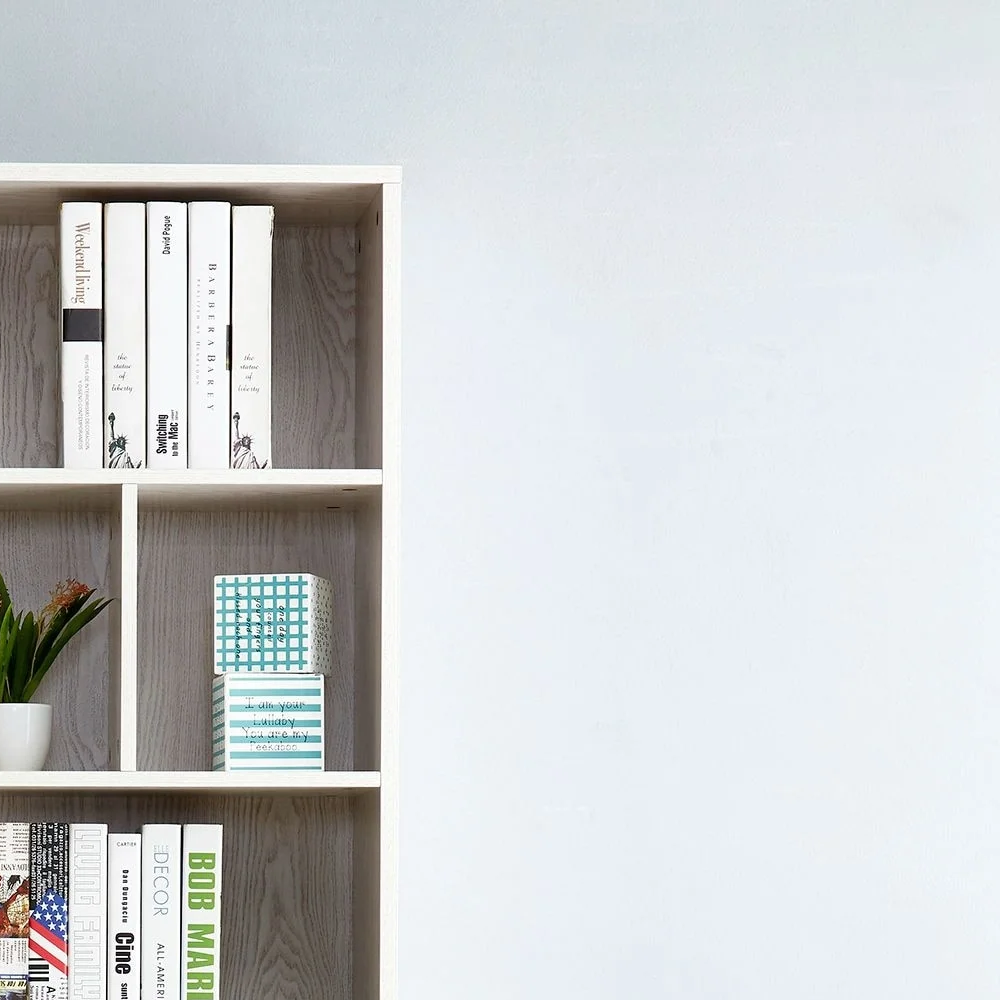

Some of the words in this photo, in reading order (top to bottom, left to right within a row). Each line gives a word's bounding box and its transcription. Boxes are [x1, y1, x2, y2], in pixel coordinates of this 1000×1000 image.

[162, 215, 171, 236] Pogue
[75, 222, 91, 273] Weekend
[162, 237, 171, 255] David
[71, 275, 91, 304] living
[156, 414, 169, 454] Switching
[168, 422, 178, 440] Mac
[278, 701, 306, 713] your
[153, 852, 169, 916] DECOR
[188, 852, 216, 910] BOB
[115, 932, 135, 975] Cine
